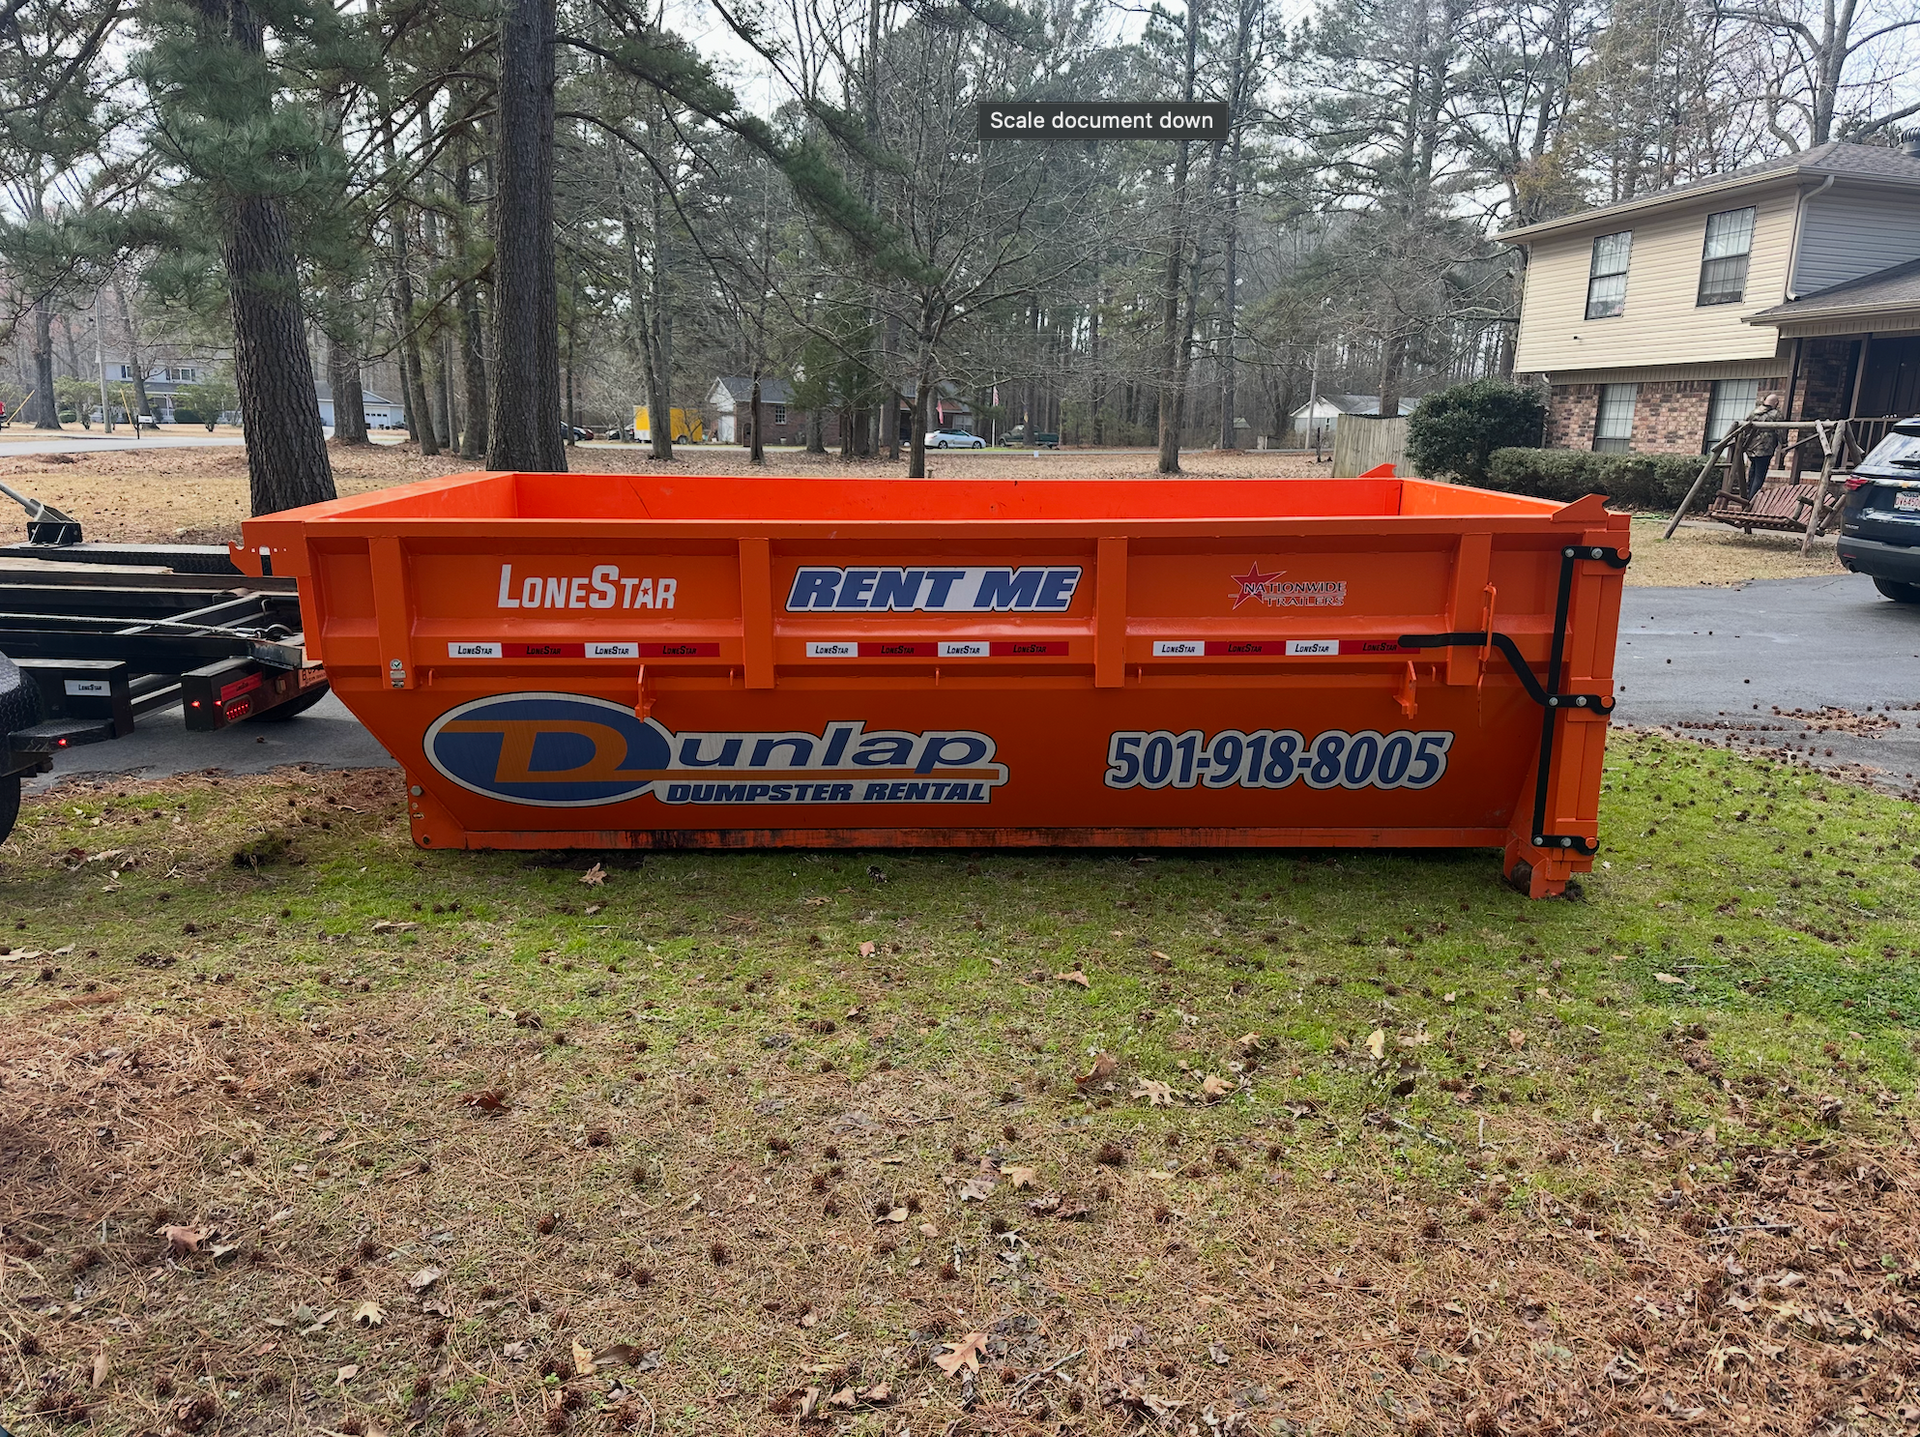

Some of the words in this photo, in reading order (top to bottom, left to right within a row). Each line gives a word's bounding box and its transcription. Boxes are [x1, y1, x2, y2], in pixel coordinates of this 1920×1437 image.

[787, 569, 967, 610] RENT
[972, 569, 1081, 610] ME
[1243, 581, 1347, 594] NATIONWIDE
[1264, 596, 1344, 607] TRAILERS
[438, 719, 990, 784] Dunlap
[1109, 734, 1448, 785] 501-918-8005
[666, 782, 857, 801] DUMPSTER
[864, 782, 986, 801] RENTAL
